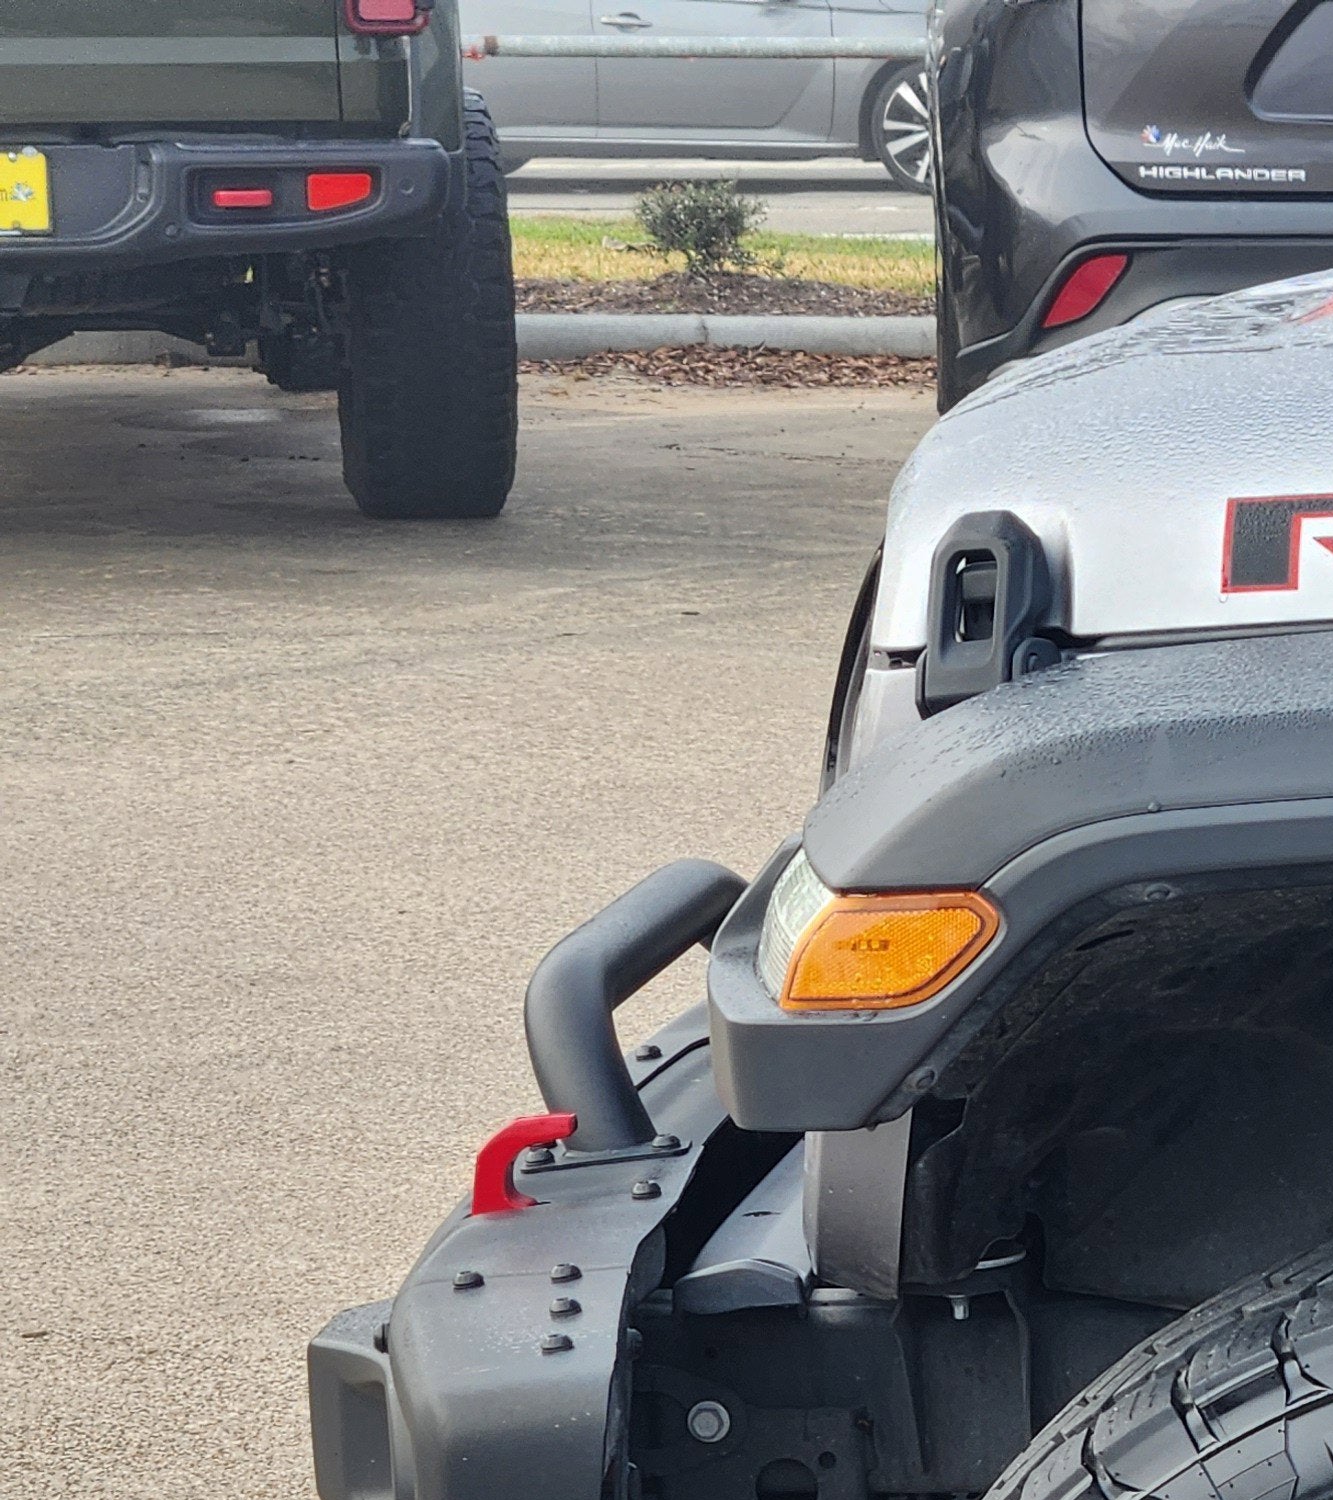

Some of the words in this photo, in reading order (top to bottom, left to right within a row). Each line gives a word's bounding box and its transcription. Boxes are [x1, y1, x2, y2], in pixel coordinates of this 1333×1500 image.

[1160, 132, 1191, 156] Mac
[1193, 131, 1245, 157] Haik
[1138, 165, 1307, 182] HIGHLANDER
